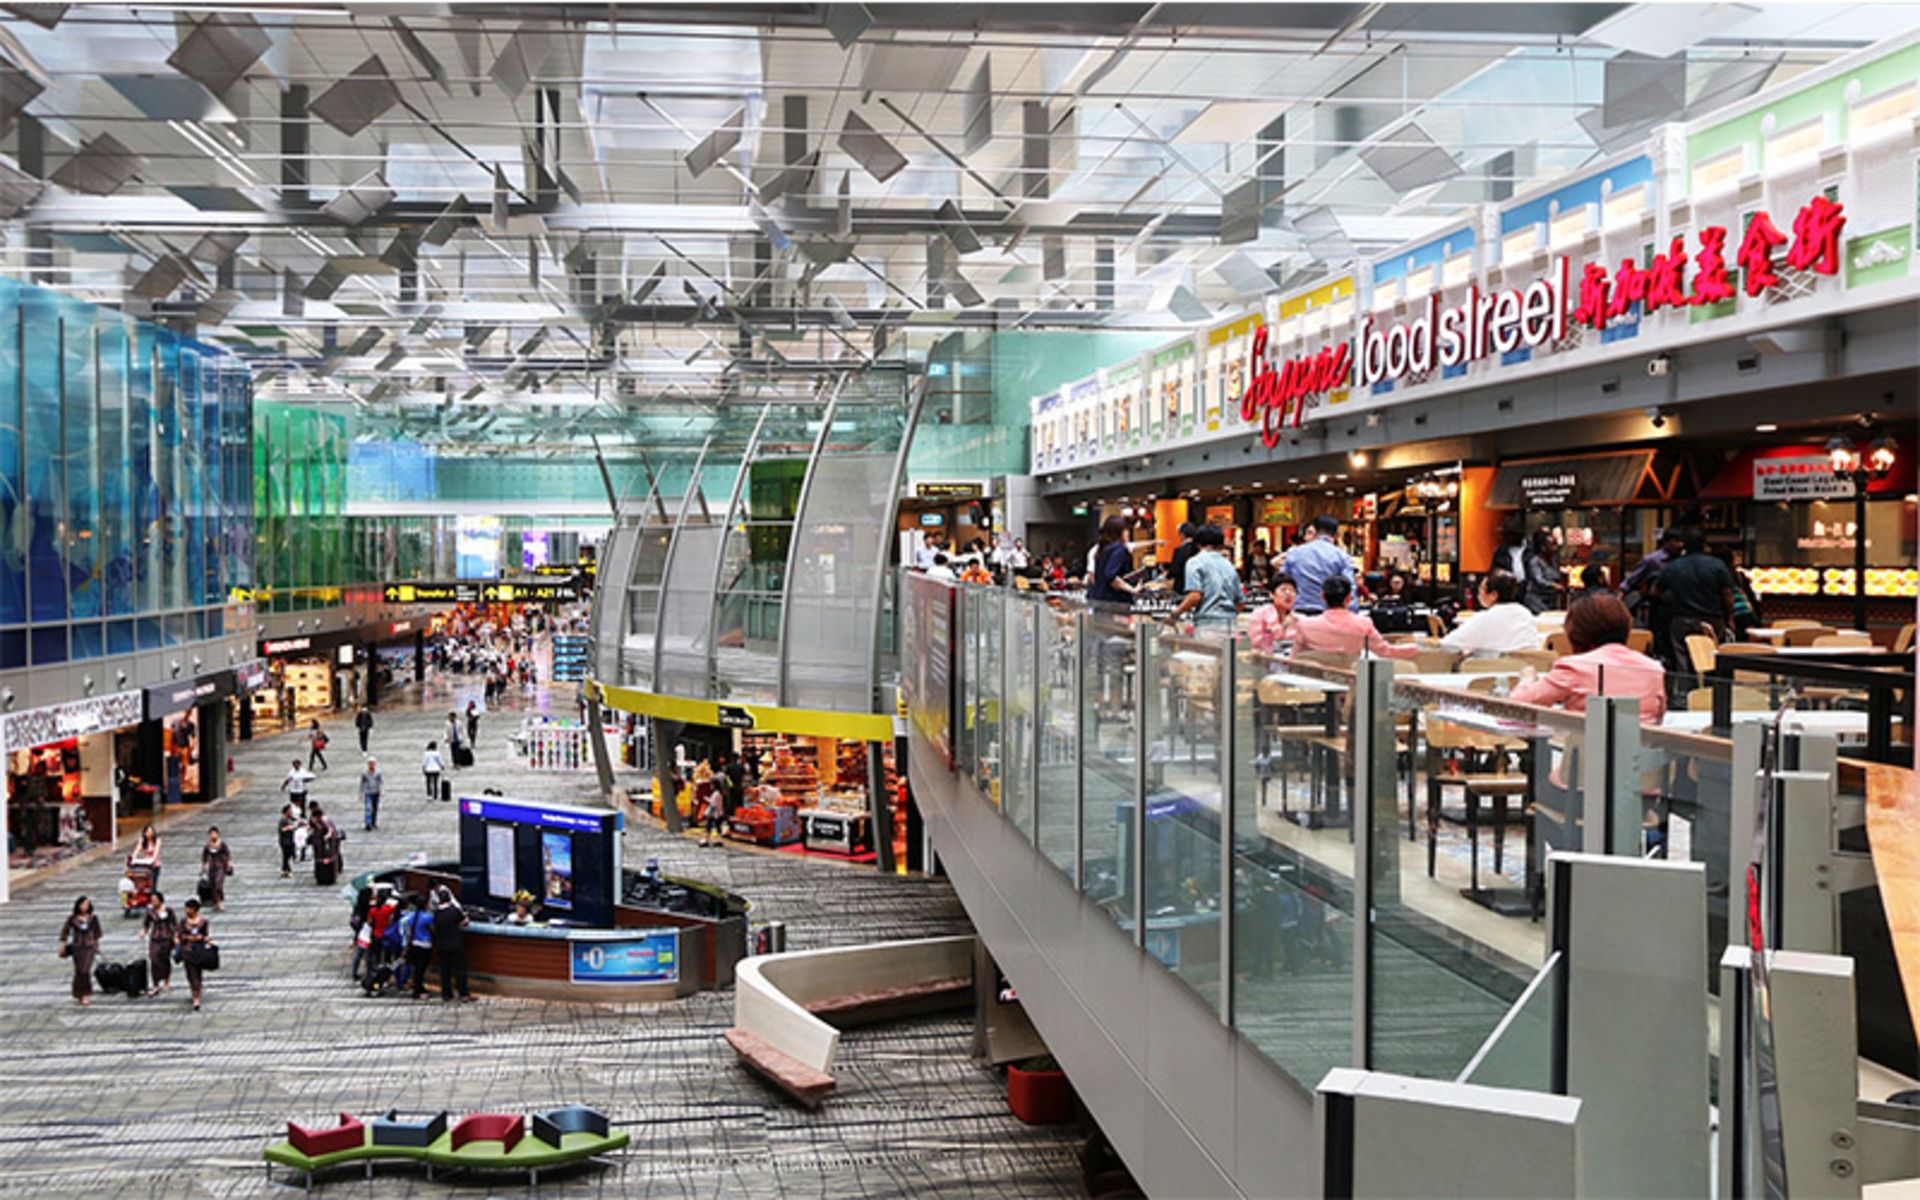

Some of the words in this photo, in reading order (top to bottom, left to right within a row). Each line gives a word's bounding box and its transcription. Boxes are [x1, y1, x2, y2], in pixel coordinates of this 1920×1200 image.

[1356, 289, 1440, 388] food
[1438, 255, 1570, 368] street
[1573, 195, 1846, 330] 新加坡美食街
